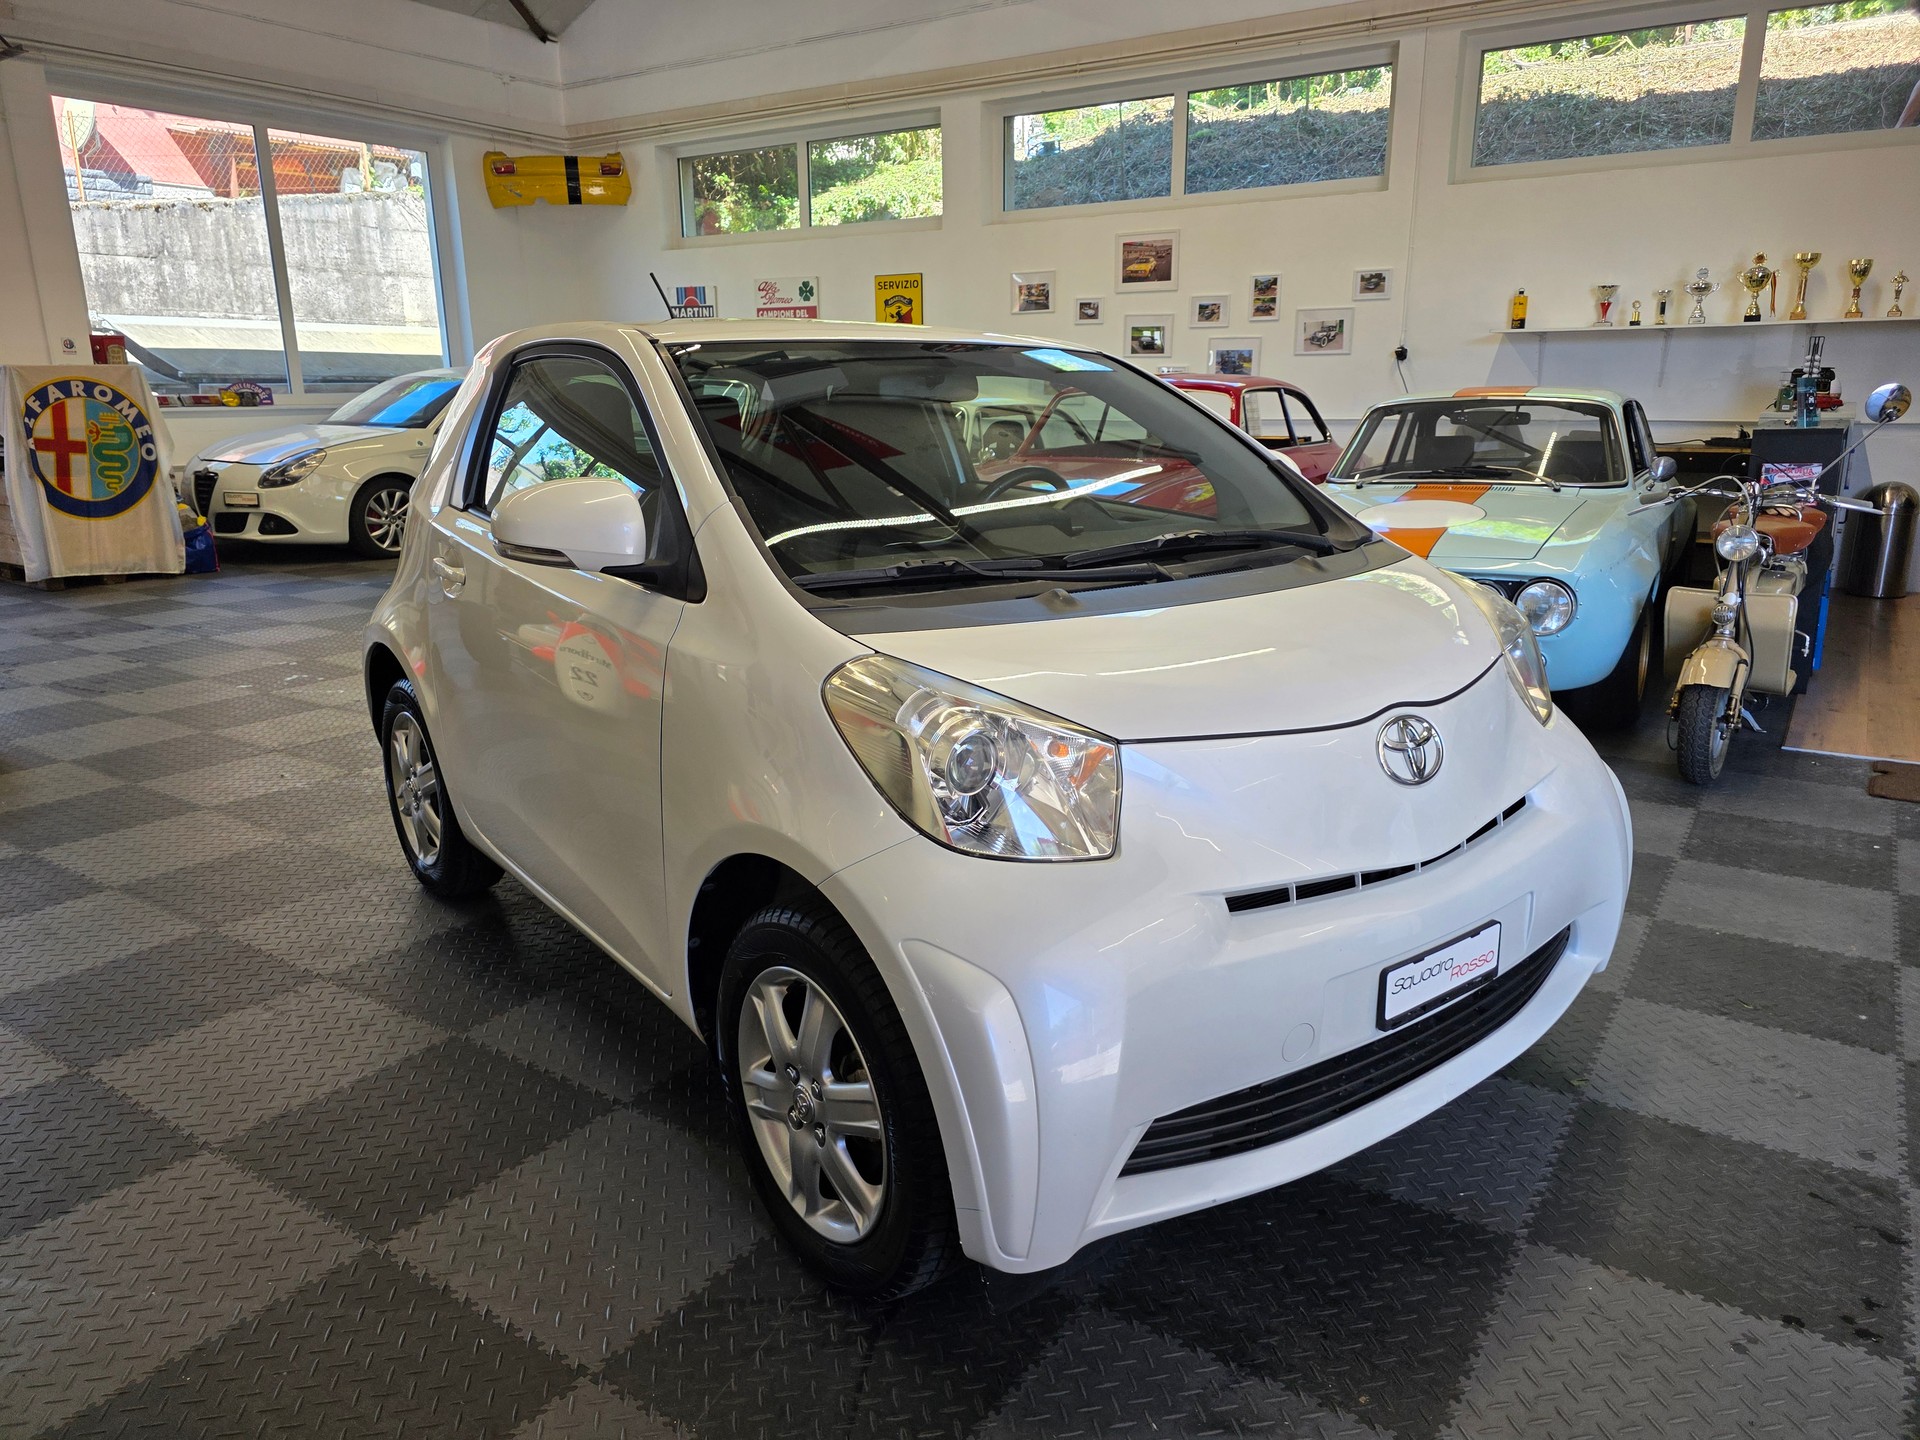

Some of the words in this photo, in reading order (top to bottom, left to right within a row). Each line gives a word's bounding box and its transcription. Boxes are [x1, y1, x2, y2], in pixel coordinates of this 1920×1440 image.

[757, 280, 781, 294] Alfa
[877, 279, 919, 291] SERVIZIO
[760, 291, 794, 306] Romeo
[671, 306, 714, 318] MARTINI
[758, 309, 795, 318] CAMPIONE
[795, 308, 809, 318] DEL
[70, 380, 158, 462] ROMEO
